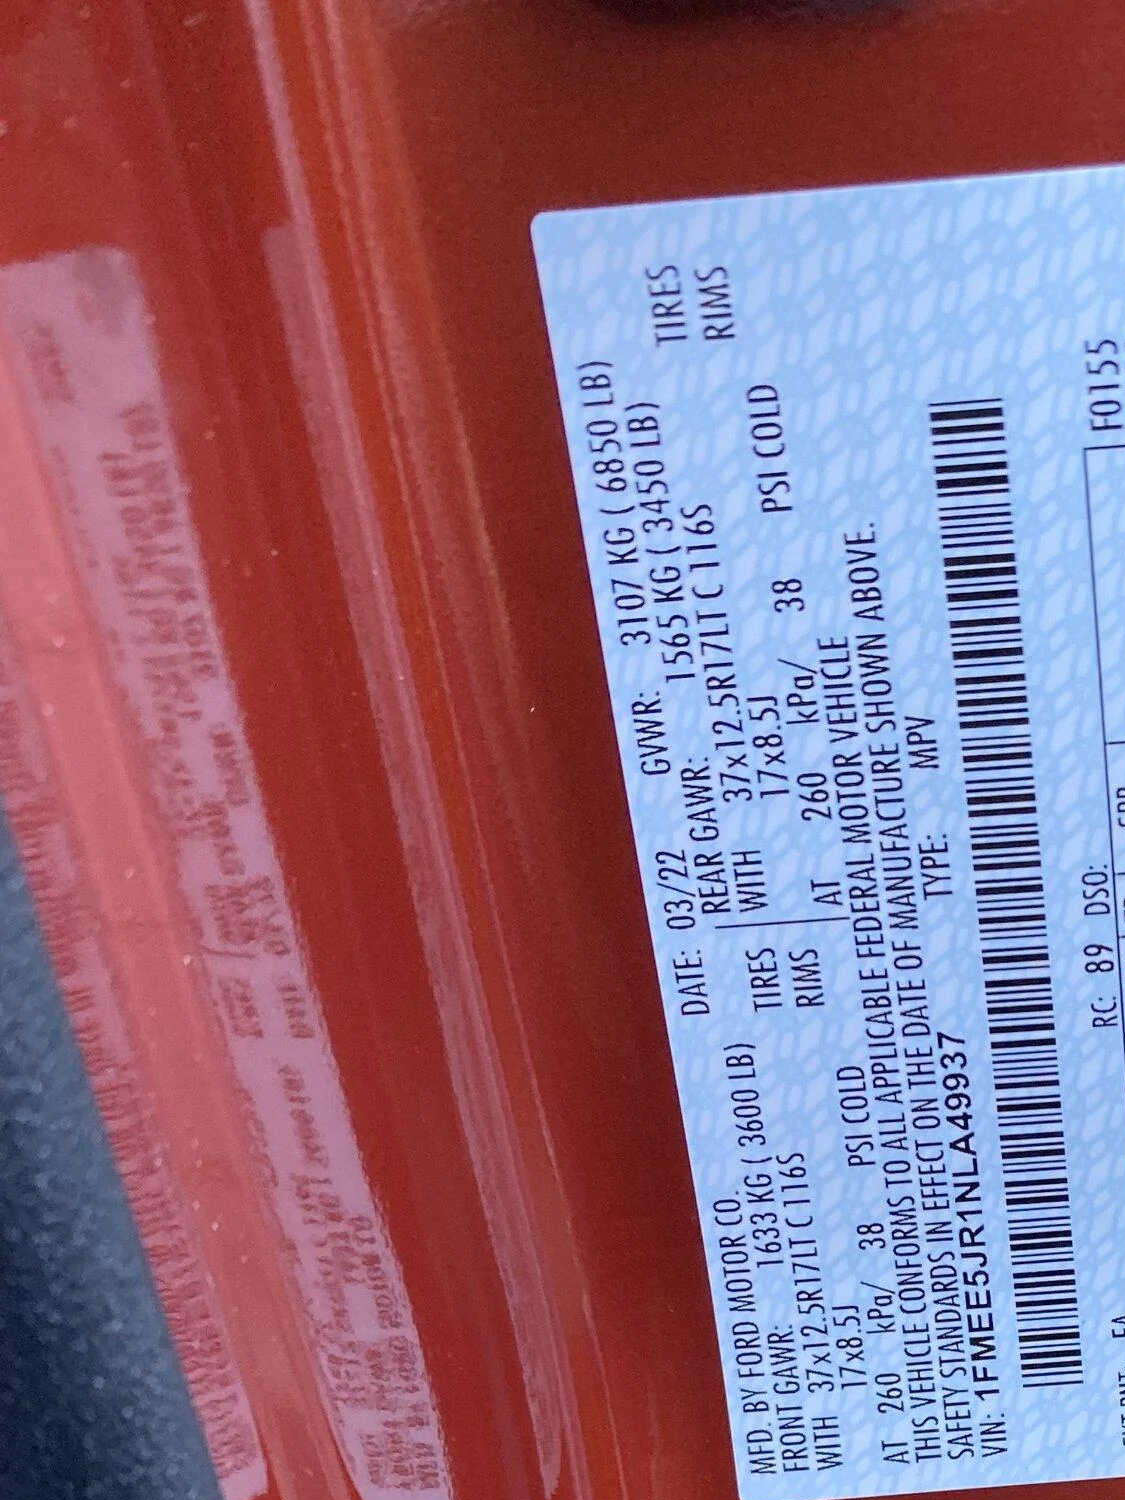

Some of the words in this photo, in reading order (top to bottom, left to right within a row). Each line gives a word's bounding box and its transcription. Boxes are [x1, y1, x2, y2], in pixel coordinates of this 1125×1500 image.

[577, 360, 615, 407] LB)
[1085, 338, 1124, 432] F0155
[624, 402, 662, 448] LB)
[746, 384, 786, 459] COLD
[586, 419, 628, 493] 6850
[633, 459, 674, 534] 3450
[756, 470, 793, 513] PSI
[603, 526, 640, 566] KG
[679, 503, 721, 573] 116S
[649, 565, 685, 604] KG
[691, 584, 724, 600] C
[771, 577, 805, 614] 38
[843, 522, 885, 622] ABOVE.
[610, 578, 652, 646] 3107
[656, 613, 696, 683] 1565
[695, 610, 754, 803] 37x12.5R17LT
[777, 658, 821, 725] kPa/
[816, 636, 860, 744] VEHICLE
[855, 633, 897, 734] SHOWN
[630, 690, 672, 776] GVWR:
[746, 695, 791, 800] 17x8.5J
[904, 715, 940, 769] MPV
[679, 756, 720, 842] GAWR:
[796, 771, 833, 822] 260
[831, 751, 873, 844] MOTOR
[868, 742, 919, 930] MANUFACTURE
[654, 849, 697, 931] 03/22
[693, 850, 732, 915] REAR
[730, 849, 769, 913] WITH
[810, 879, 844, 906] AT
[917, 833, 954, 901] TYPE:
[1081, 864, 1112, 916] DSO:
[845, 852, 886, 959] FEDERAL
[672, 949, 711, 1016] DATE:
[745, 947, 783, 1013] TIRES
[787, 948, 826, 1008] RIMS
[891, 939, 924, 971] OF
[1083, 943, 1115, 974] 89
[858, 967, 904, 1105] APPLICABLE
[895, 978, 932, 1038] DATE
[1090, 995, 1119, 1028] RC:
[723, 1042, 757, 1080] LB)
[903, 1045, 937, 1090] THE
[730, 1088, 767, 1148] 3600
[835, 1065, 871, 1124] COLD
[909, 1097, 942, 1130] ON
[844, 1133, 877, 1167] PSI
[877, 1111, 910, 1152] ALL
[743, 1173, 776, 1204] KG
[775, 1152, 812, 1208] 116S
[882, 1159, 914, 1189] TO
[914, 1139, 951, 1211] EFFECT
[712, 1190, 744, 1227] CO.
[784, 1215, 814, 1228] C
[856, 1222, 887, 1251] 38
[924, 1220, 955, 1244] IN
[936, 1031, 1001, 1402] 1FMEE5JR1NLA49937
[749, 1211, 785, 1269] 1633
[886, 1195, 928, 1315] CONFORMS
[718, 1233, 757, 1313] MOTOR
[787, 1237, 835, 1394] 37x12.5R17LT
[859, 1280, 897, 1335] kPa/
[926, 1250, 968, 1379] STANDARDS
[731, 1320, 766, 1379] FORD
[766, 1324, 801, 1395] GAWR:
[830, 1304, 869, 1391] 17x8.5J
[901, 1322, 937, 1410] VEHICLE
[739, 1387, 770, 1414] BY
[873, 1372, 905, 1414] 260
[745, 1422, 778, 1475] MFD.
[775, 1403, 810, 1473] FRONT
[810, 1415, 844, 1472] WITH
[880, 1439, 911, 1465] AT
[911, 1415, 943, 1464] THIS
[940, 1386, 975, 1461] SAFETY
[978, 1412, 1009, 1458] VIN:
